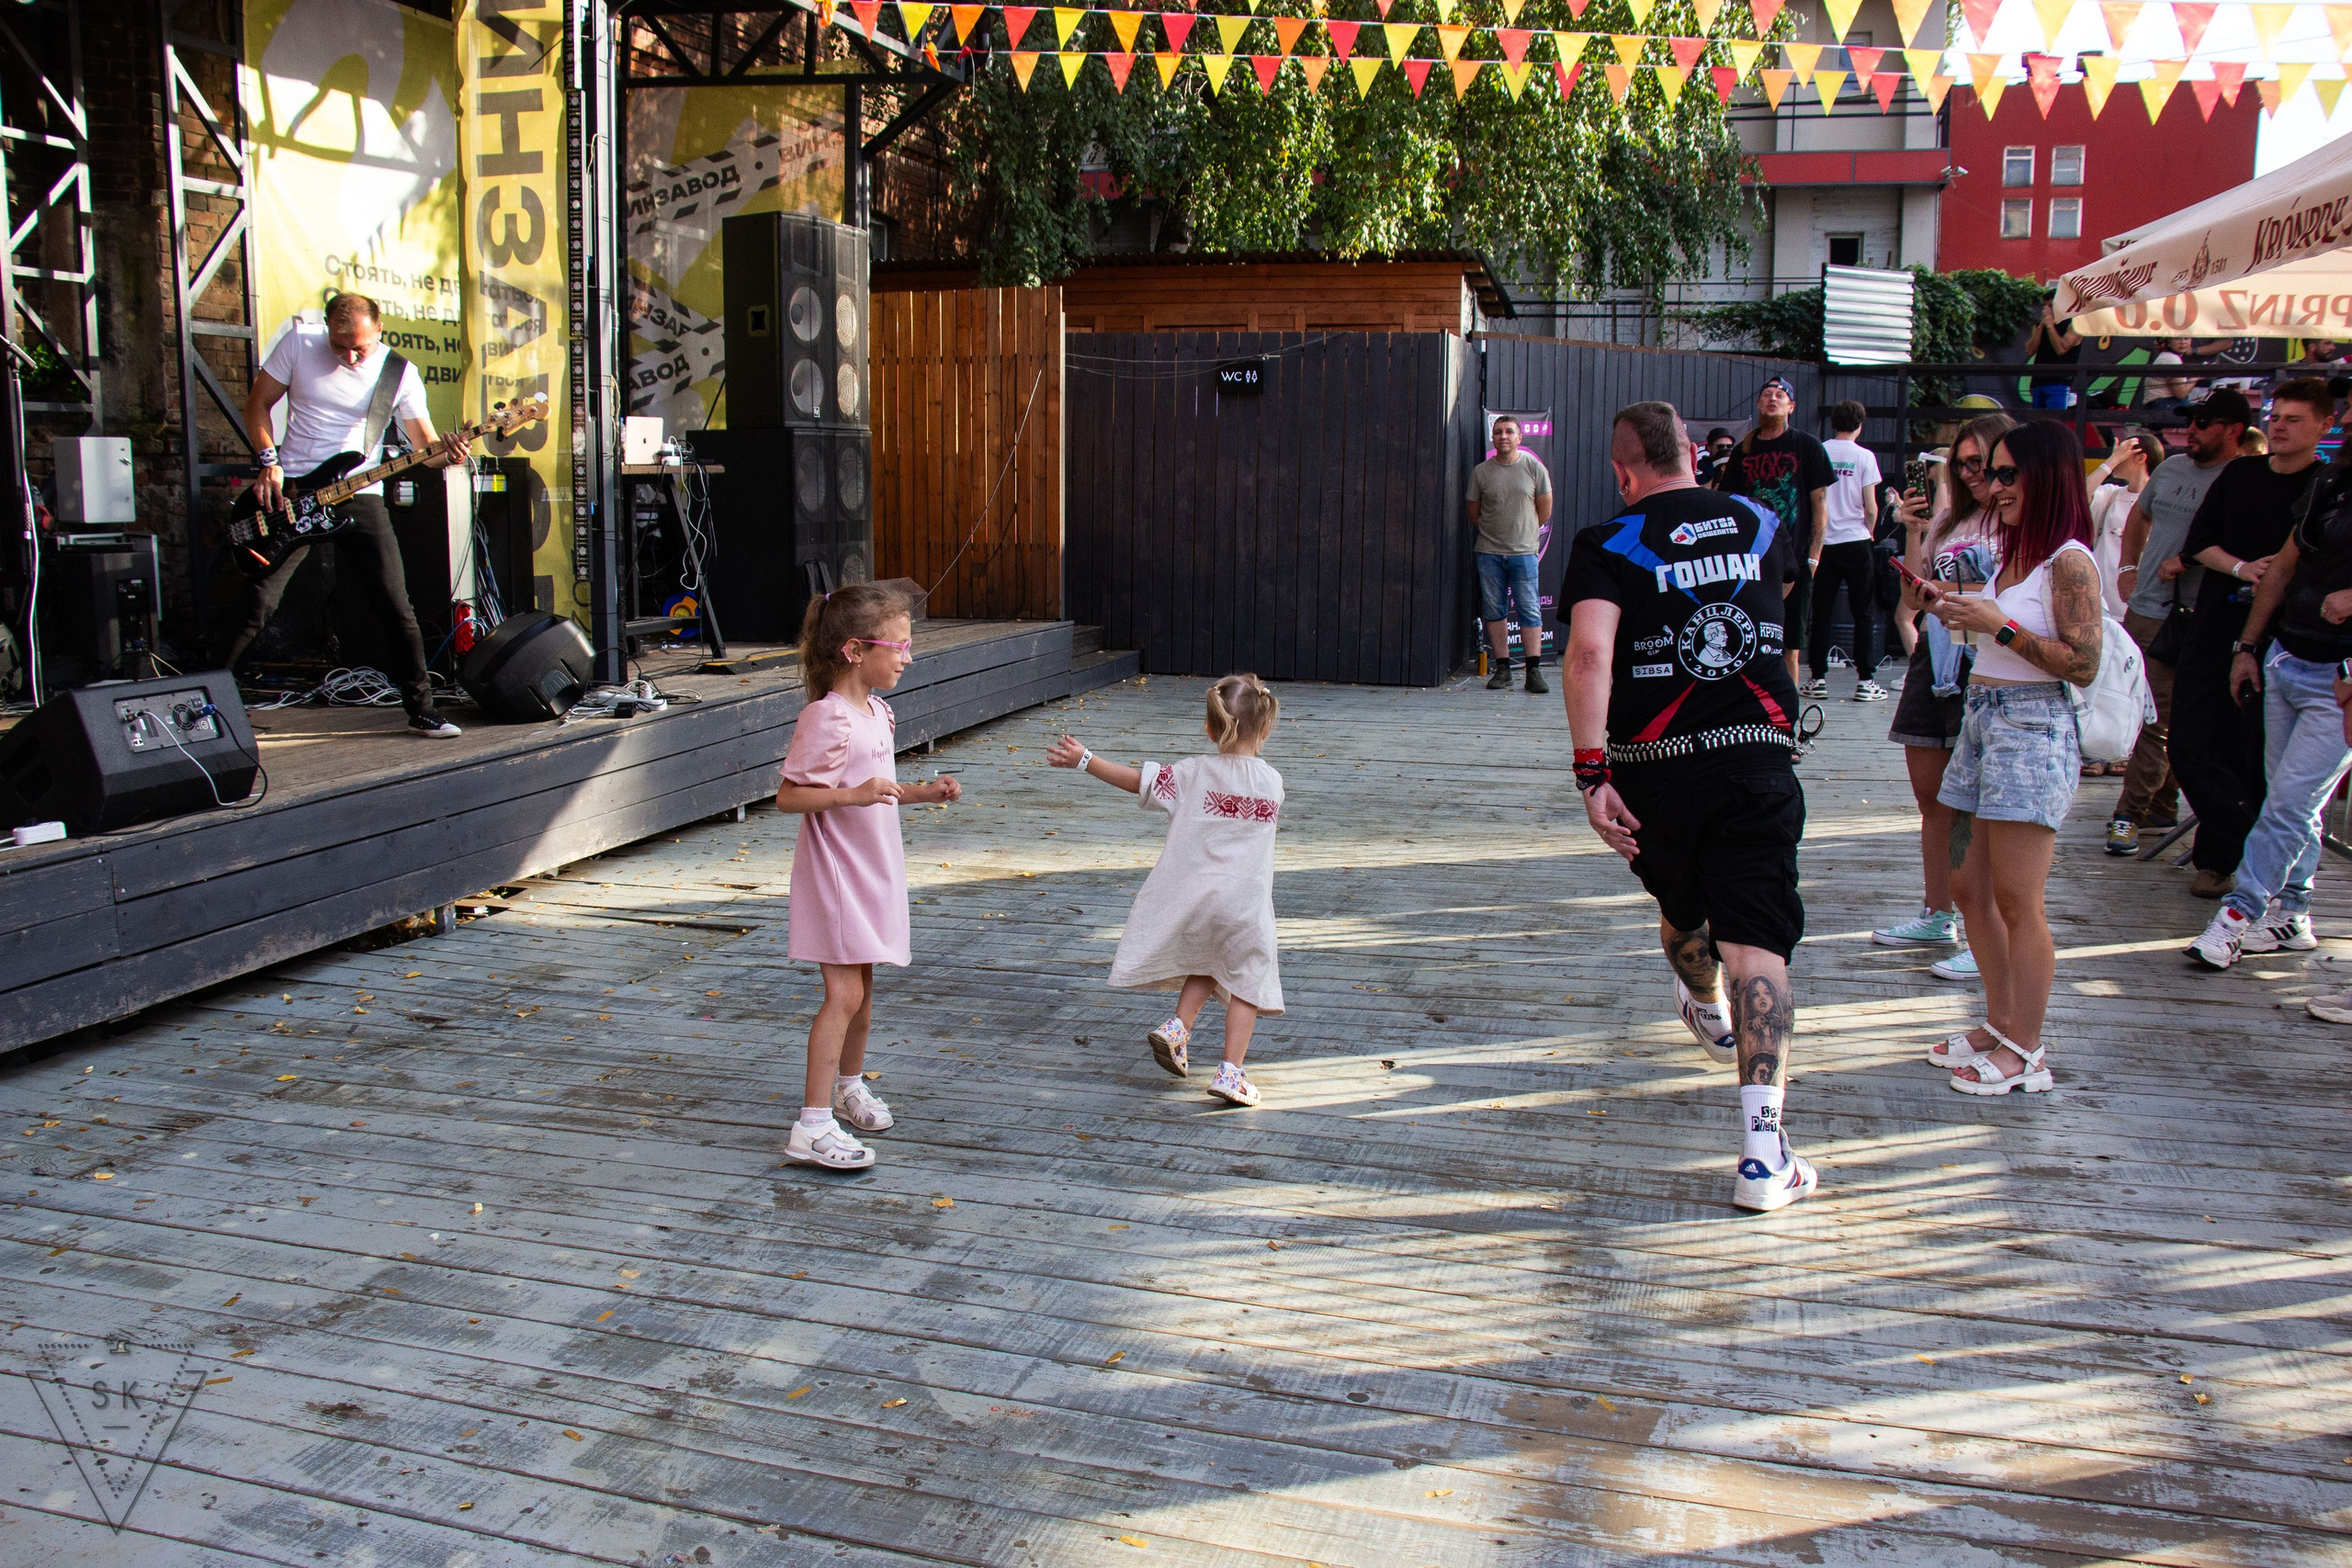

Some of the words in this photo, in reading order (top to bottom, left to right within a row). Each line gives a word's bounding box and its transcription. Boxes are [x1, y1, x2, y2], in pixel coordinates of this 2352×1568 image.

[325, 254, 406, 289] Стоять,
[413, 274, 435, 291] не
[413, 304, 437, 321] не
[1221, 371, 1242, 381] WC
[1693, 516, 1736, 533] БИТВА
[1697, 527, 1739, 539] ОБЩЕПИТОВ
[1656, 553, 1761, 593] ГОШАН
[1681, 606, 1754, 650] КАНЦЛЕРЪ
[1634, 635, 1674, 651] BROOM
[1634, 666, 1671, 676] SIBSA
[1693, 660, 1743, 677] 2010
